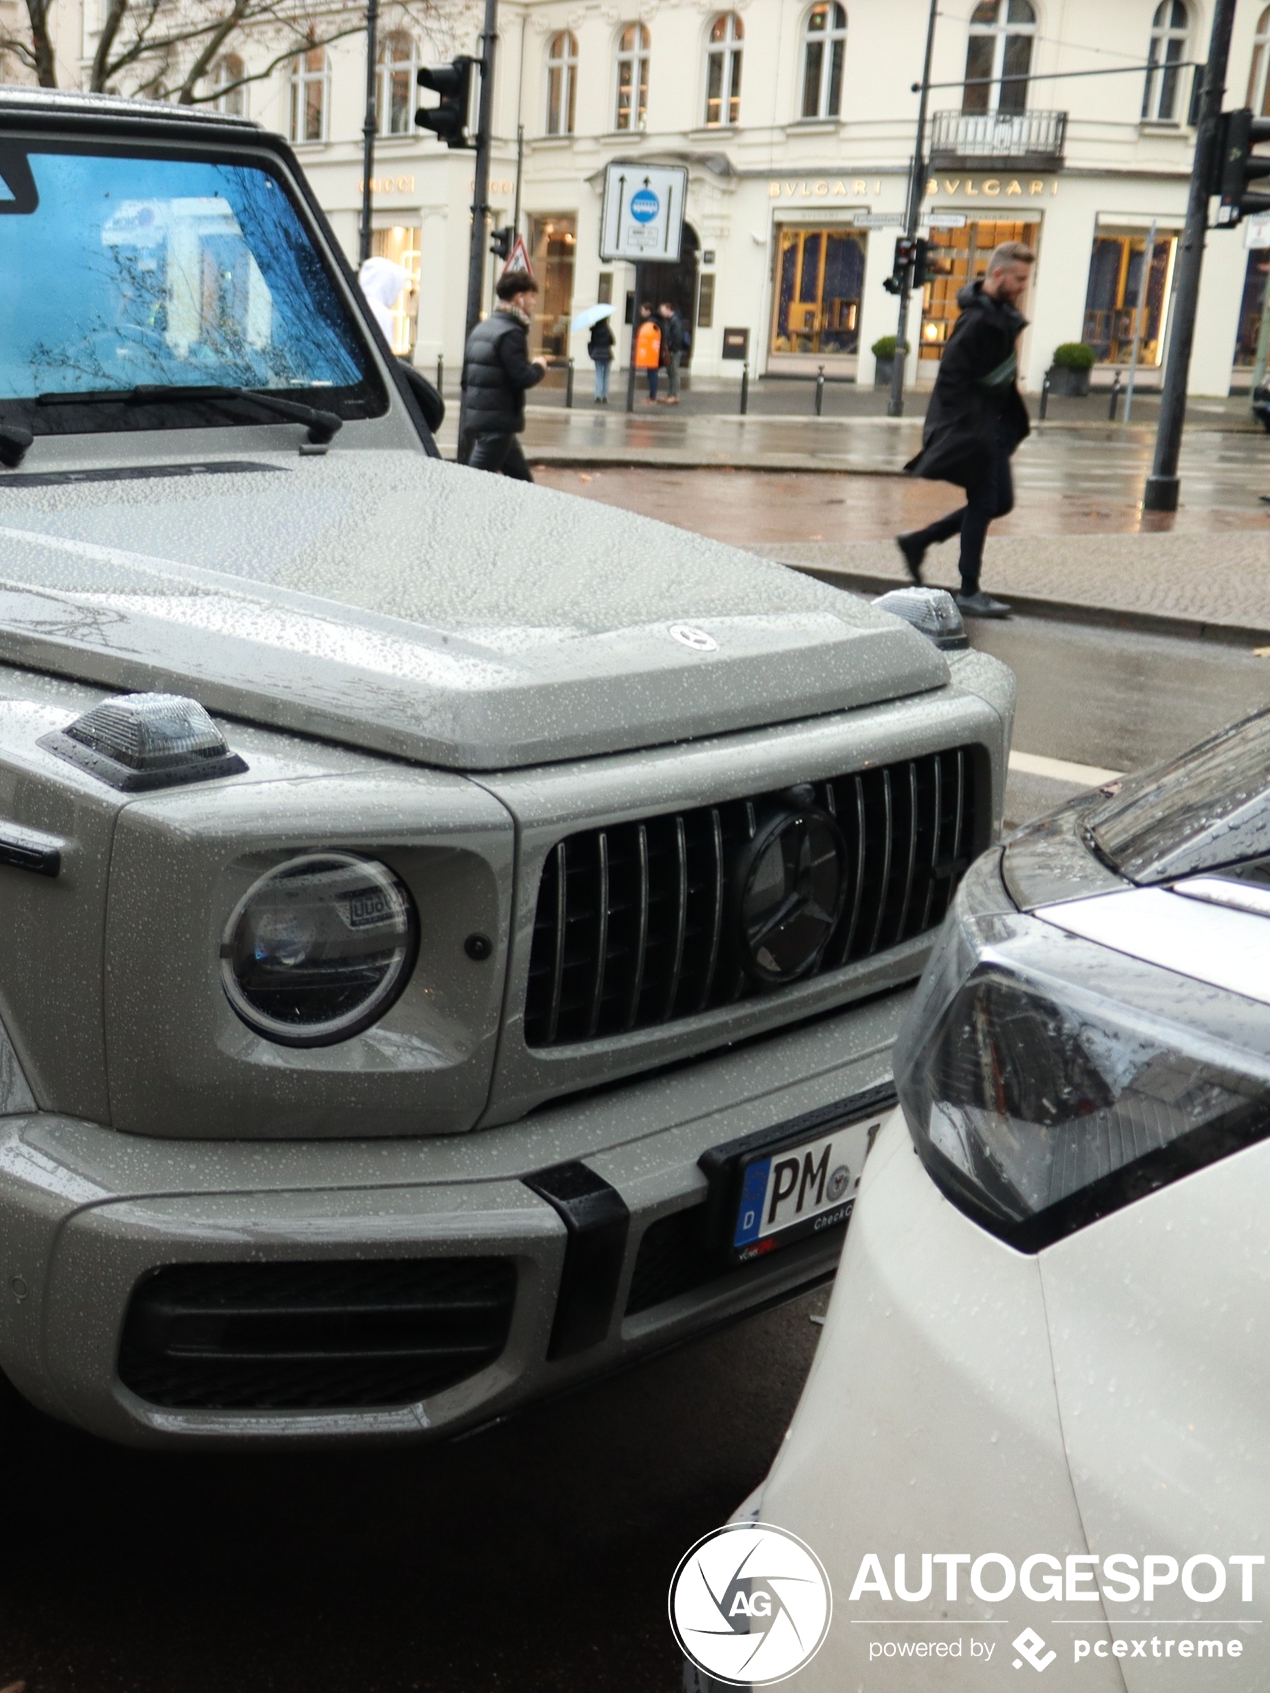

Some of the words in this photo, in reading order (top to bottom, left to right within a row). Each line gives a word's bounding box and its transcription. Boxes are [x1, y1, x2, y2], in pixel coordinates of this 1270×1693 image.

[768, 180, 882, 197] BVLGARI
[926, 178, 1059, 196] BVLGARI
[742, 1210, 755, 1230] D
[767, 1143, 832, 1224] PM
